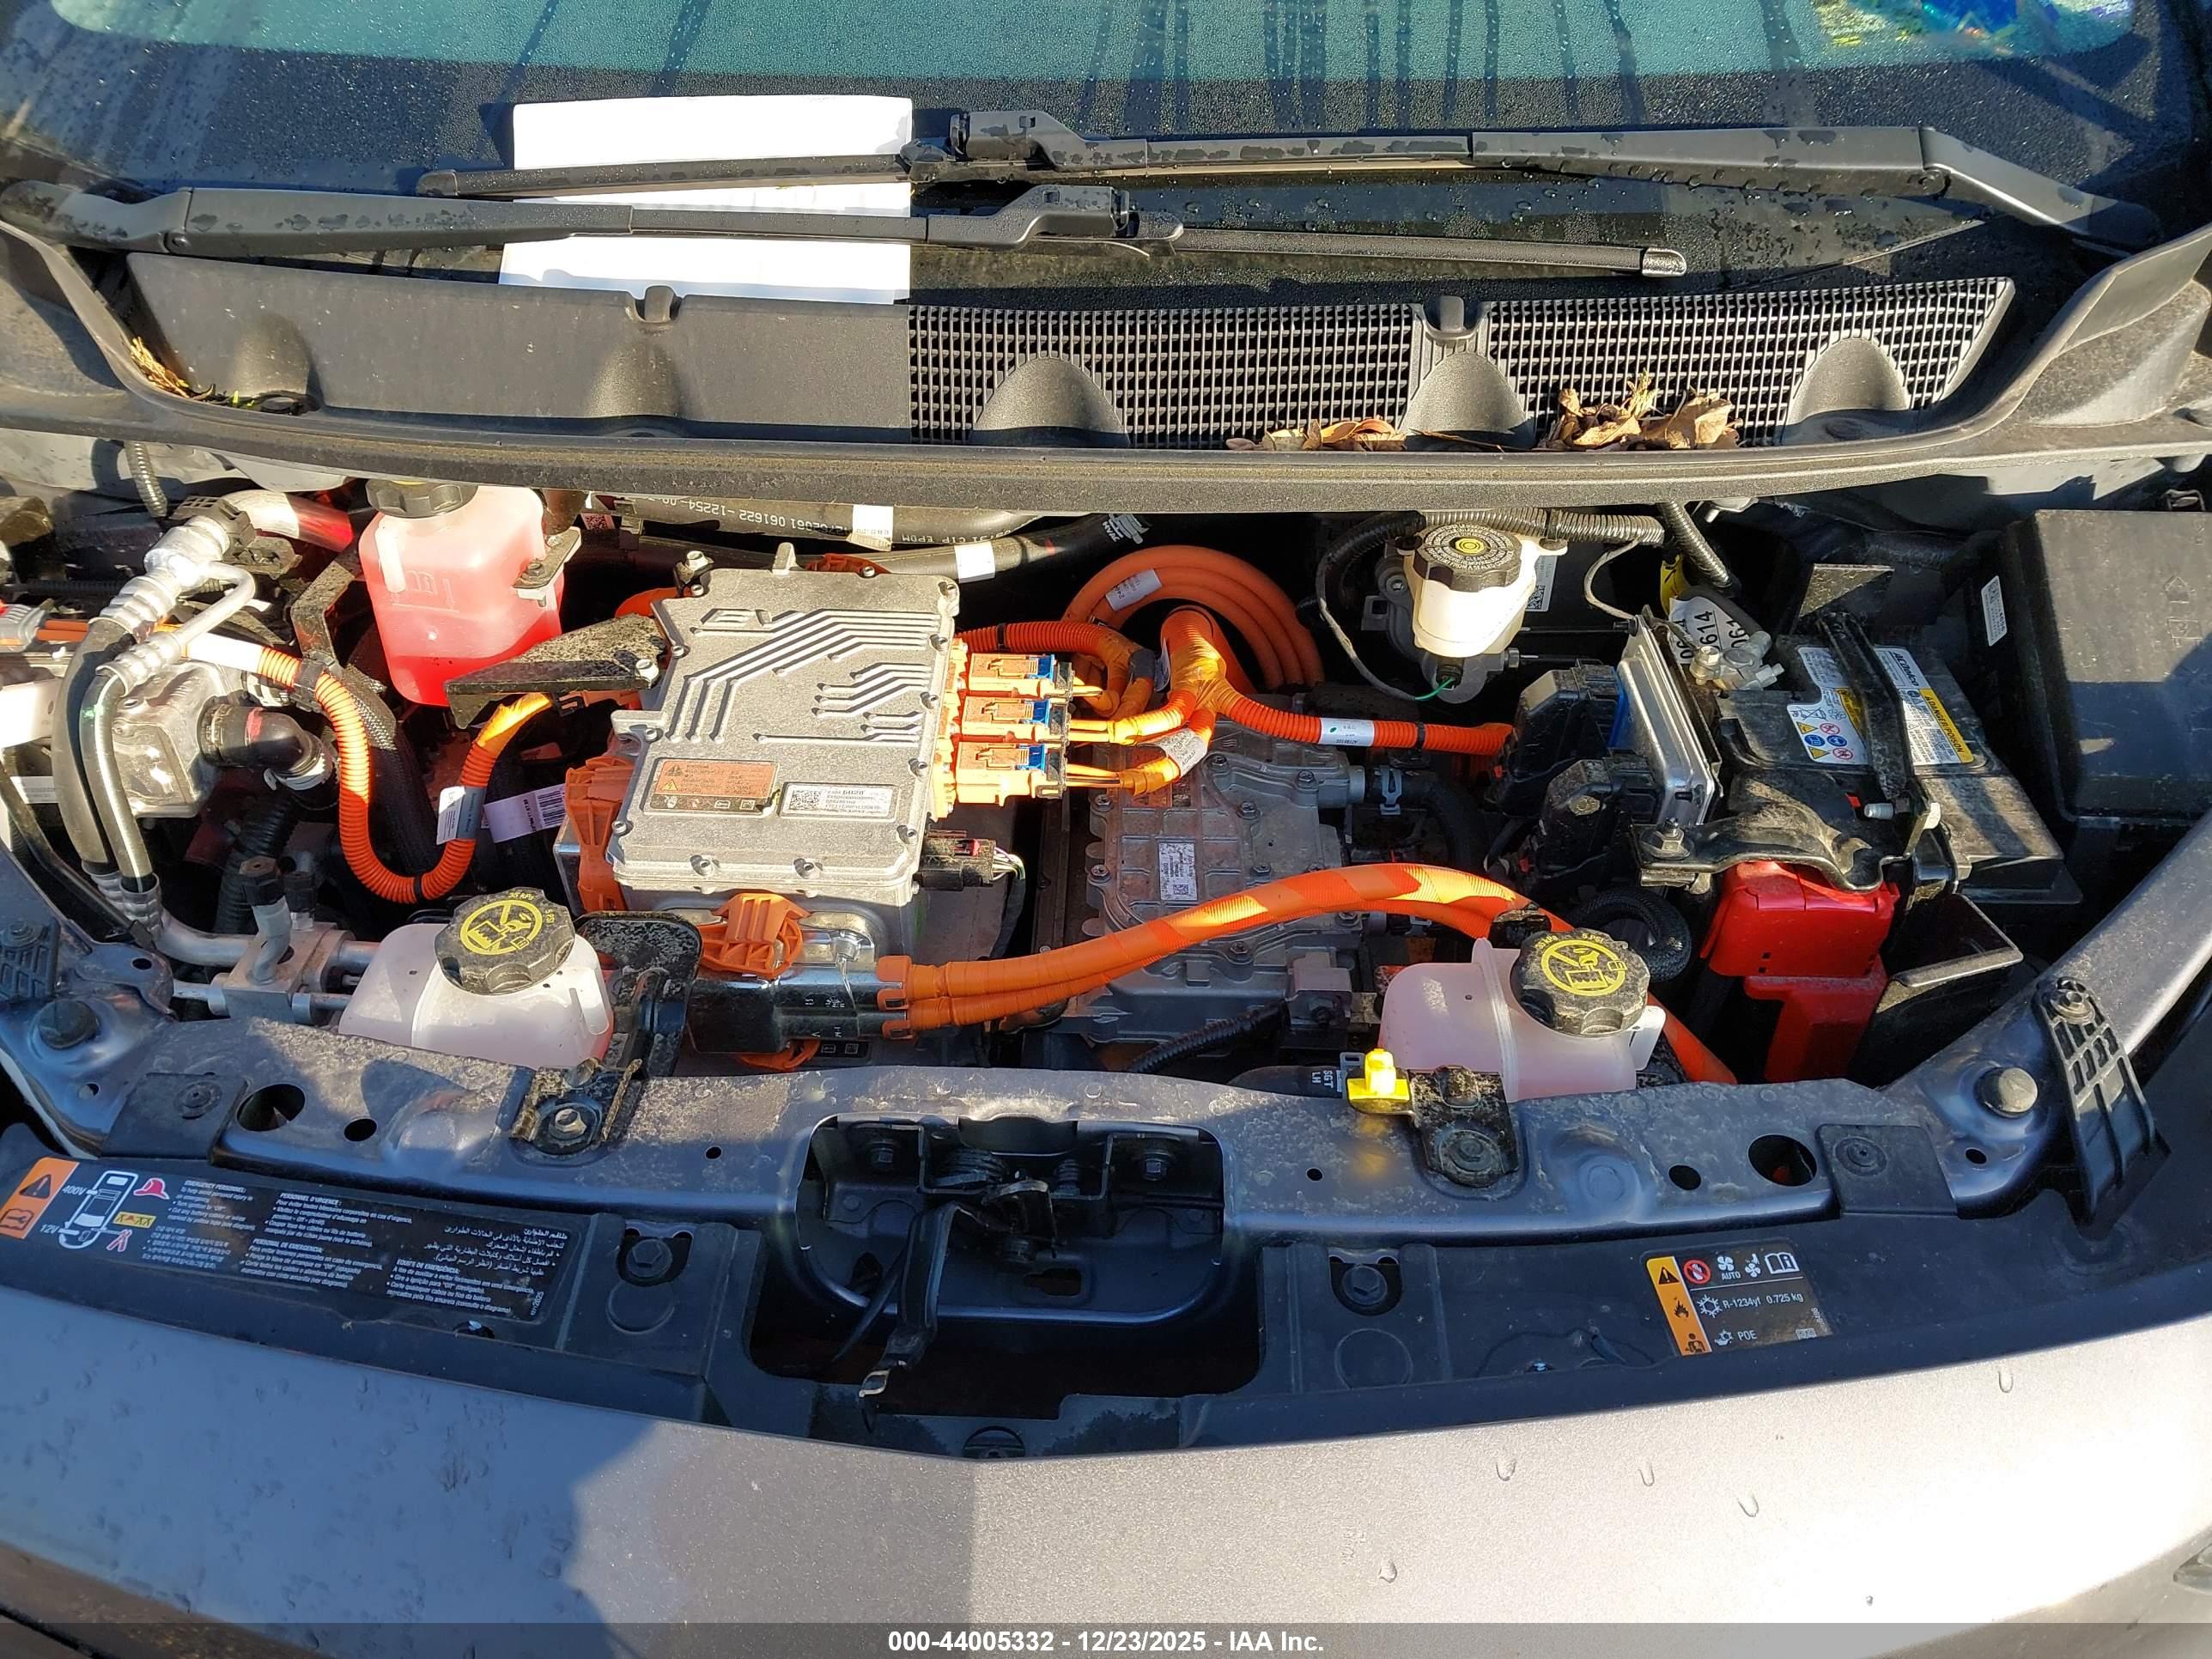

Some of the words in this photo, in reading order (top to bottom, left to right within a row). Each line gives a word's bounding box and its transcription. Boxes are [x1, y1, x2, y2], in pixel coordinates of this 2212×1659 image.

[738, 509, 786, 526] 061622
[1102, 521, 1121, 543] HVAC
[1695, 611, 1720, 650] 614
[1893, 651, 1920, 686] ACDelco
[545, 915, 556, 923] PSI
[1544, 934, 1559, 945] kPa
[1589, 934, 1604, 943] PSI
[1312, 1072, 1322, 1084] LH
[62, 1184, 86, 1196] 400V
[40, 1224, 59, 1235] 12V
[1721, 1271, 1741, 1280] AUTO
[1723, 1294, 1761, 1310] R-1234yf
[1766, 1293, 1791, 1304] 0.725
[1793, 1293, 1803, 1303] kg
[1738, 1331, 1758, 1340] POE
